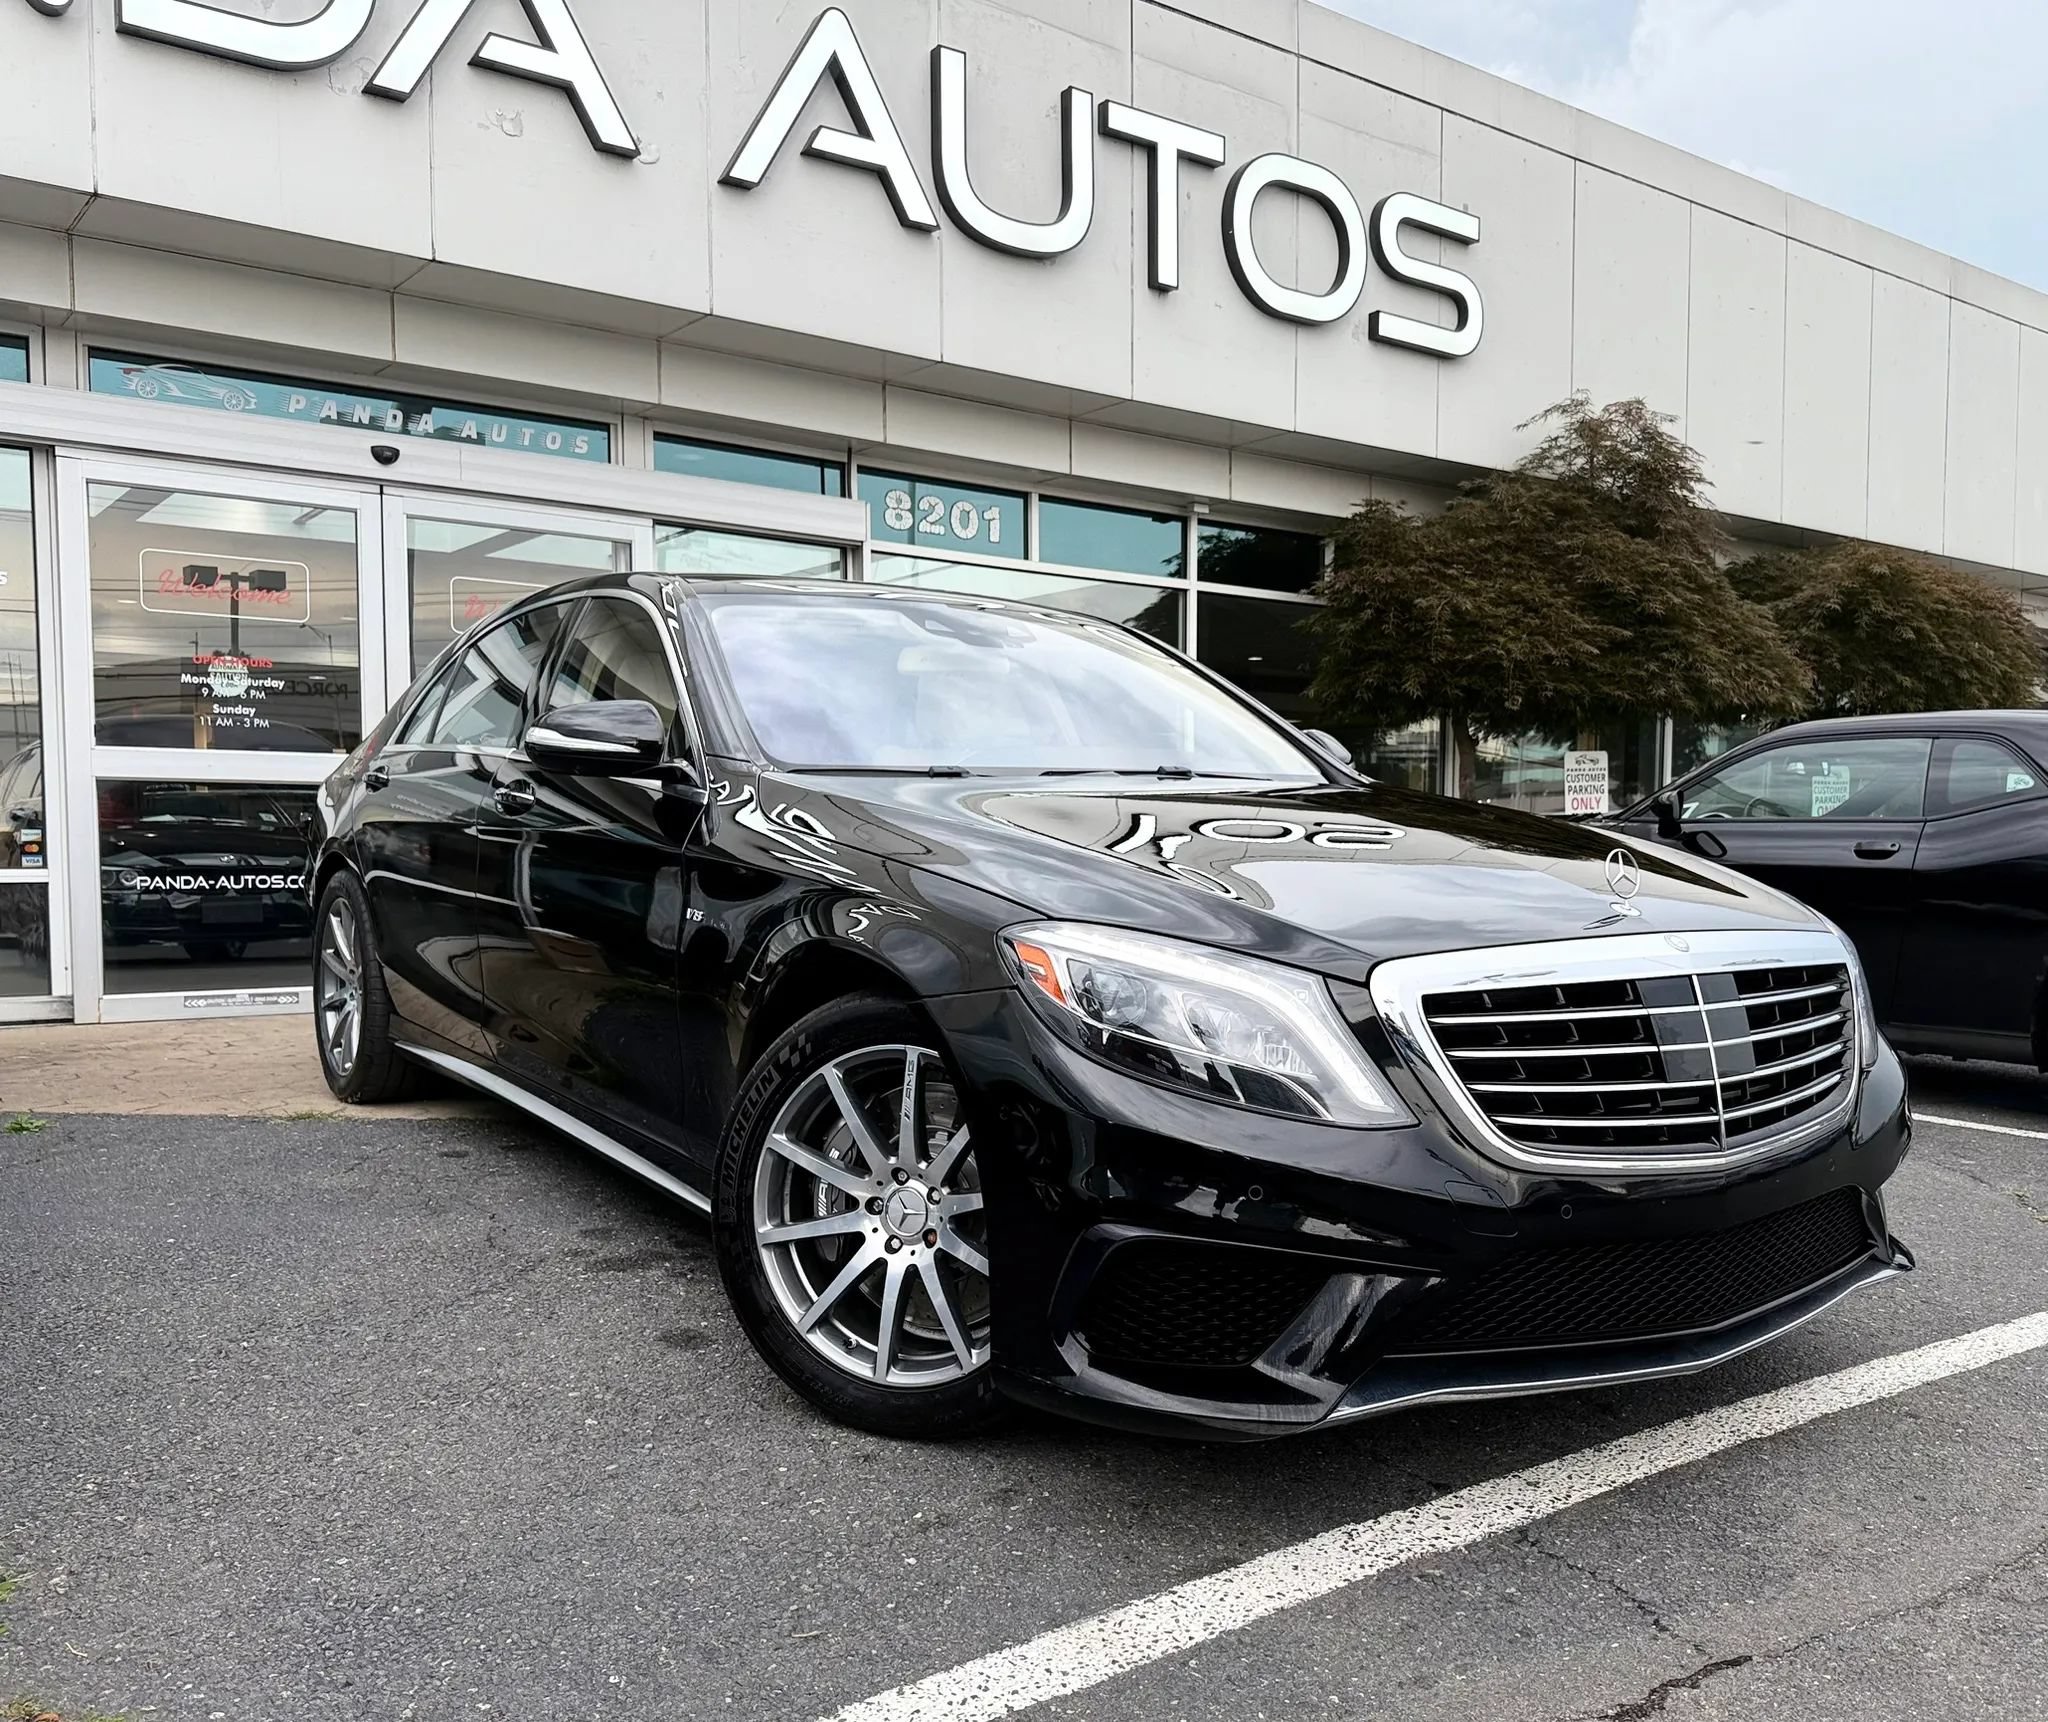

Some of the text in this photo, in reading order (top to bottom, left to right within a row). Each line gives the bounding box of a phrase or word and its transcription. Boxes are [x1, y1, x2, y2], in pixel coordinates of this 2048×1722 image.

[720, 6, 1485, 358] AUTOS
[287, 393, 589, 454] PANDA AUTOS
[884, 488, 1001, 543] 8201
[159, 568, 292, 606] Welcome
[202, 687, 209, 698] 9
[240, 689, 247, 699] 6
[250, 690, 266, 699] PM
[213, 703, 256, 717] Sunday
[200, 716, 212, 726] 11
[216, 717, 233, 727] AM
[243, 718, 250, 727] 3
[254, 718, 270, 728] PM
[1566, 773, 1606, 783] CUSTOMER
[1568, 784, 1605, 795] PARKING
[1571, 797, 1601, 810] ONLY
[686, 908, 704, 922] V8
[720, 1065, 781, 1188] MICHELIN
